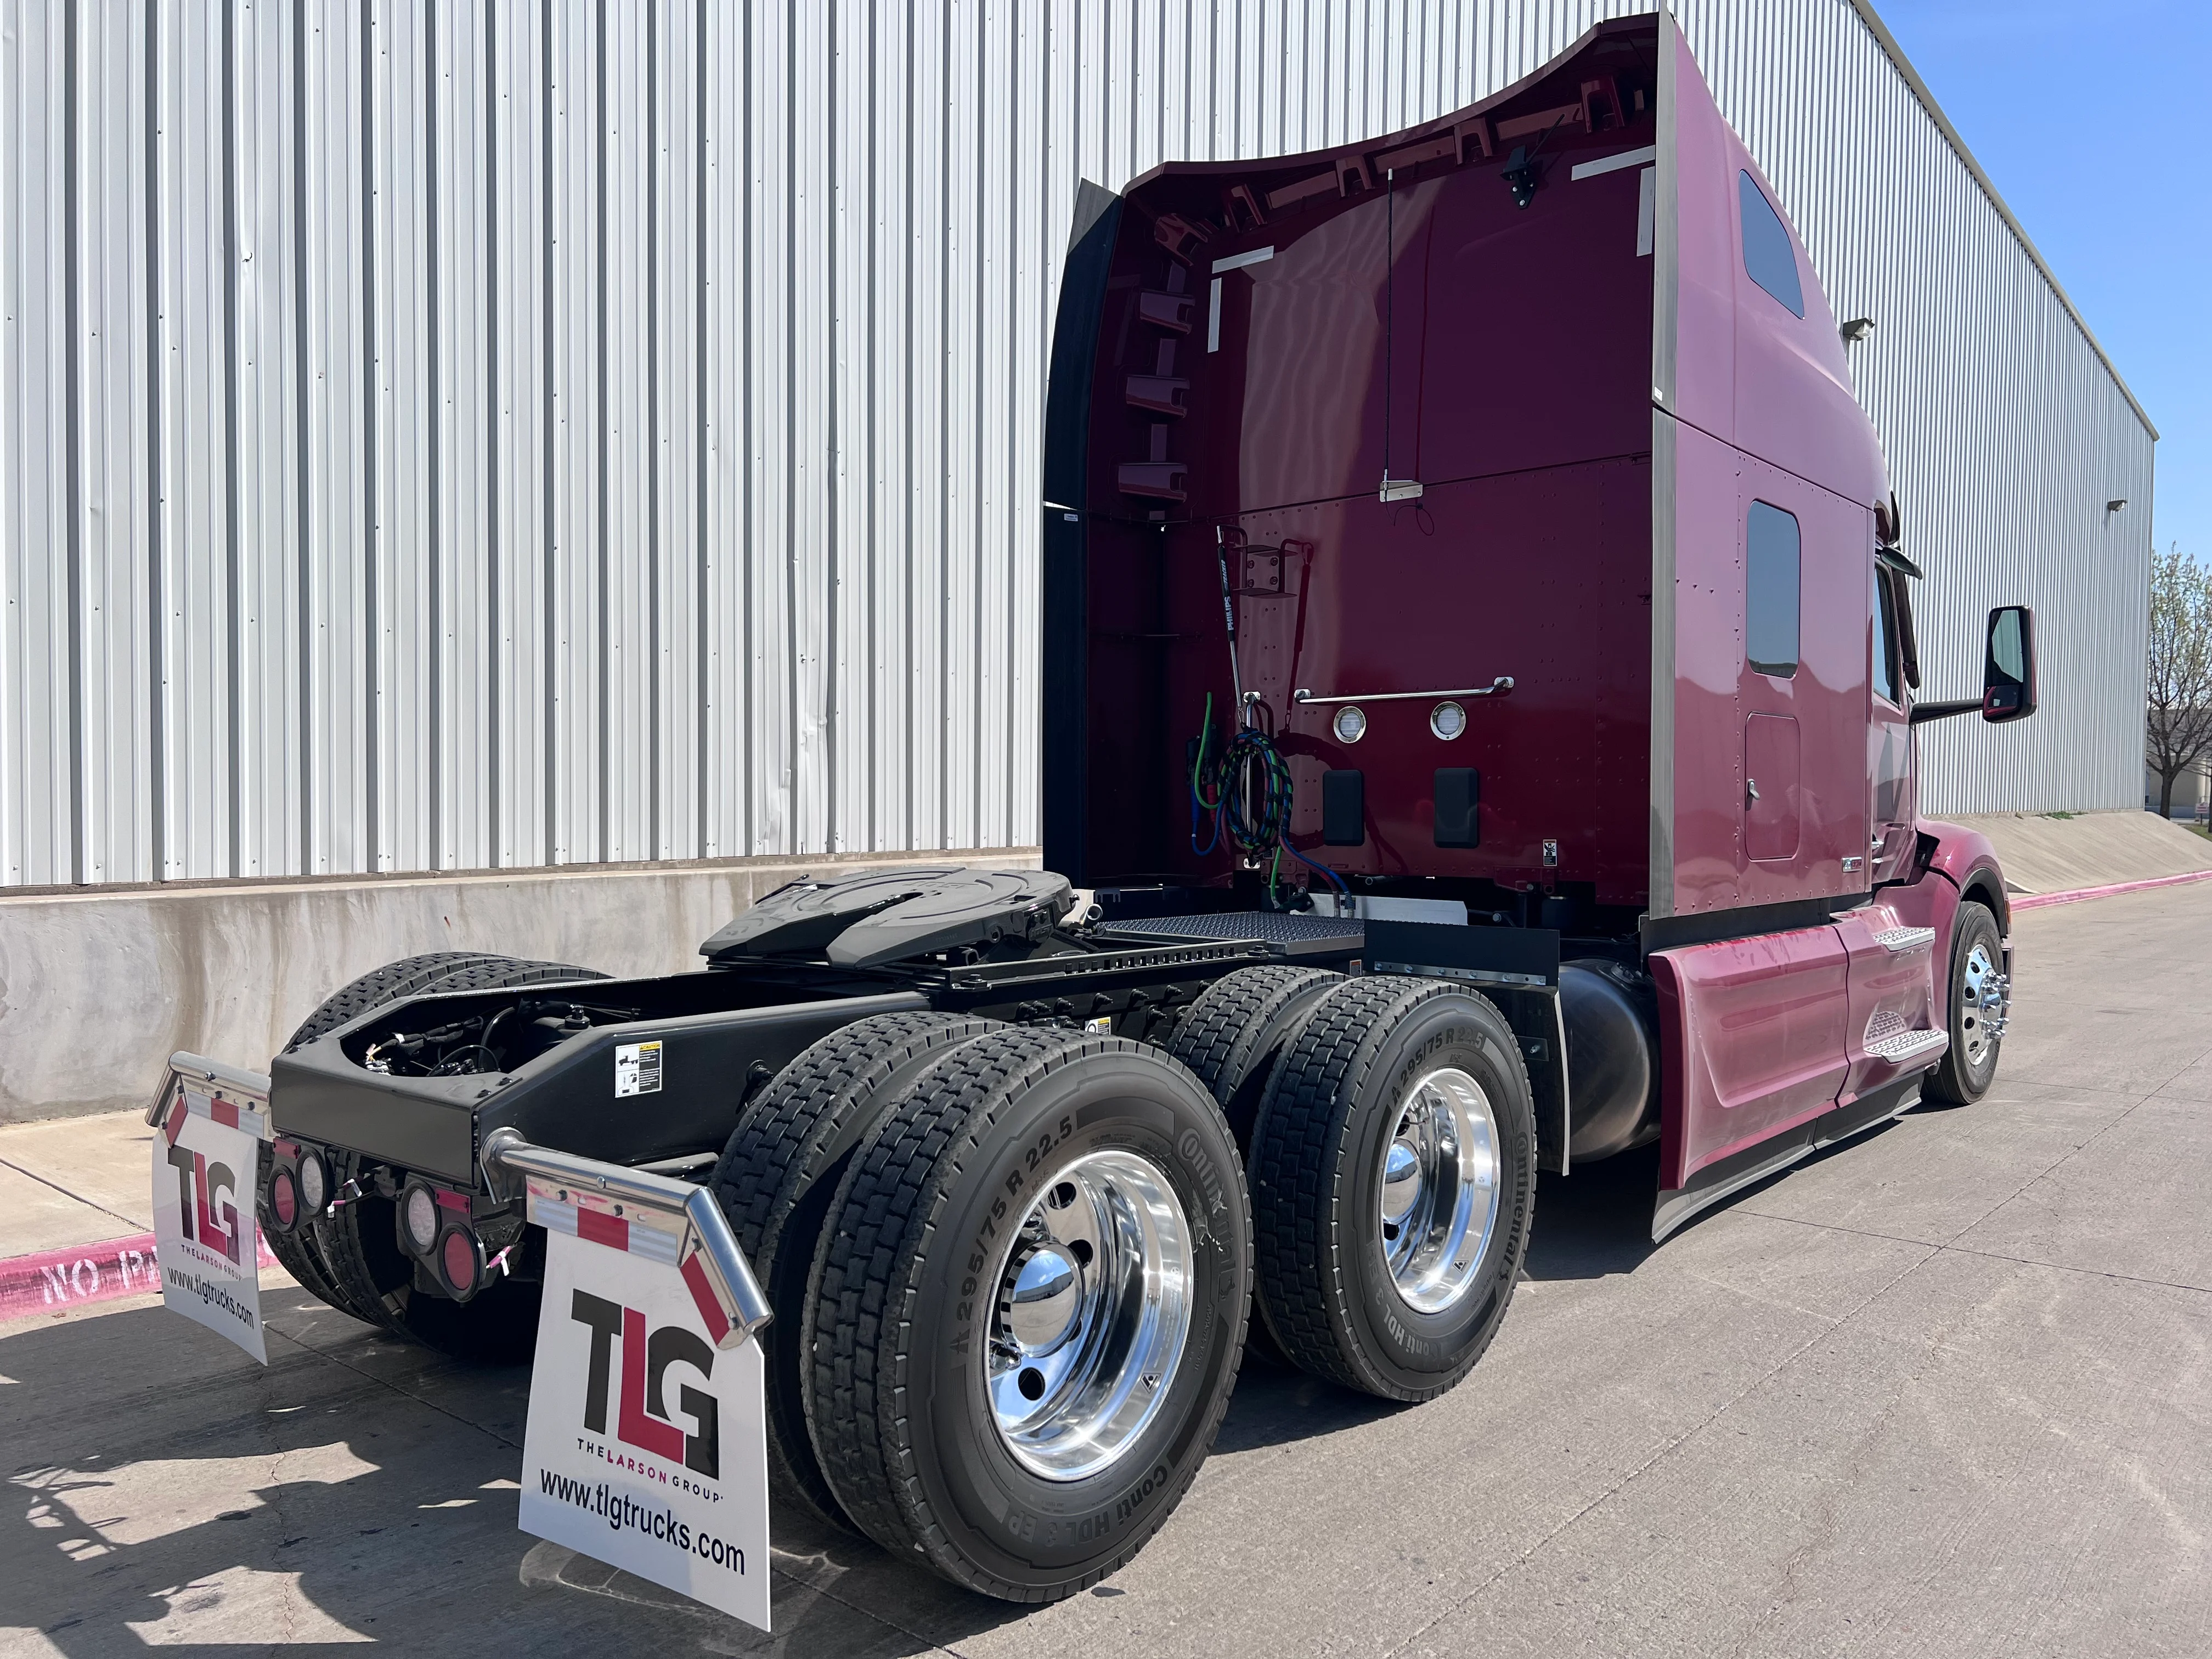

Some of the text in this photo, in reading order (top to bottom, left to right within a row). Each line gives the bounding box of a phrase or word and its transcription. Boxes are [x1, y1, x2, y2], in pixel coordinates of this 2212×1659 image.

[1401, 1031, 1443, 1088] 295/75
[1445, 1028, 1455, 1045] R
[167, 1144, 241, 1267] TLG
[956, 1115, 1073, 1322] 295/75 R 22.5
[1508, 1131, 1530, 1268] Continental
[39, 1258, 99, 1305] NO
[167, 1266, 255, 1329] www.tlgtrucks.com
[1375, 1287, 1385, 1306] 3
[1384, 1302, 1406, 1346] HDL
[571, 1288, 719, 1481] TLG
[577, 1437, 720, 1503] THE LARSON GROUP
[1115, 1463, 1169, 1526] Conti
[540, 1468, 745, 1576] www.tlgtrucks.com
[1008, 1510, 1039, 1543] EP
[1044, 1521, 1058, 1547] 3
[1065, 1510, 1110, 1547] HDL
